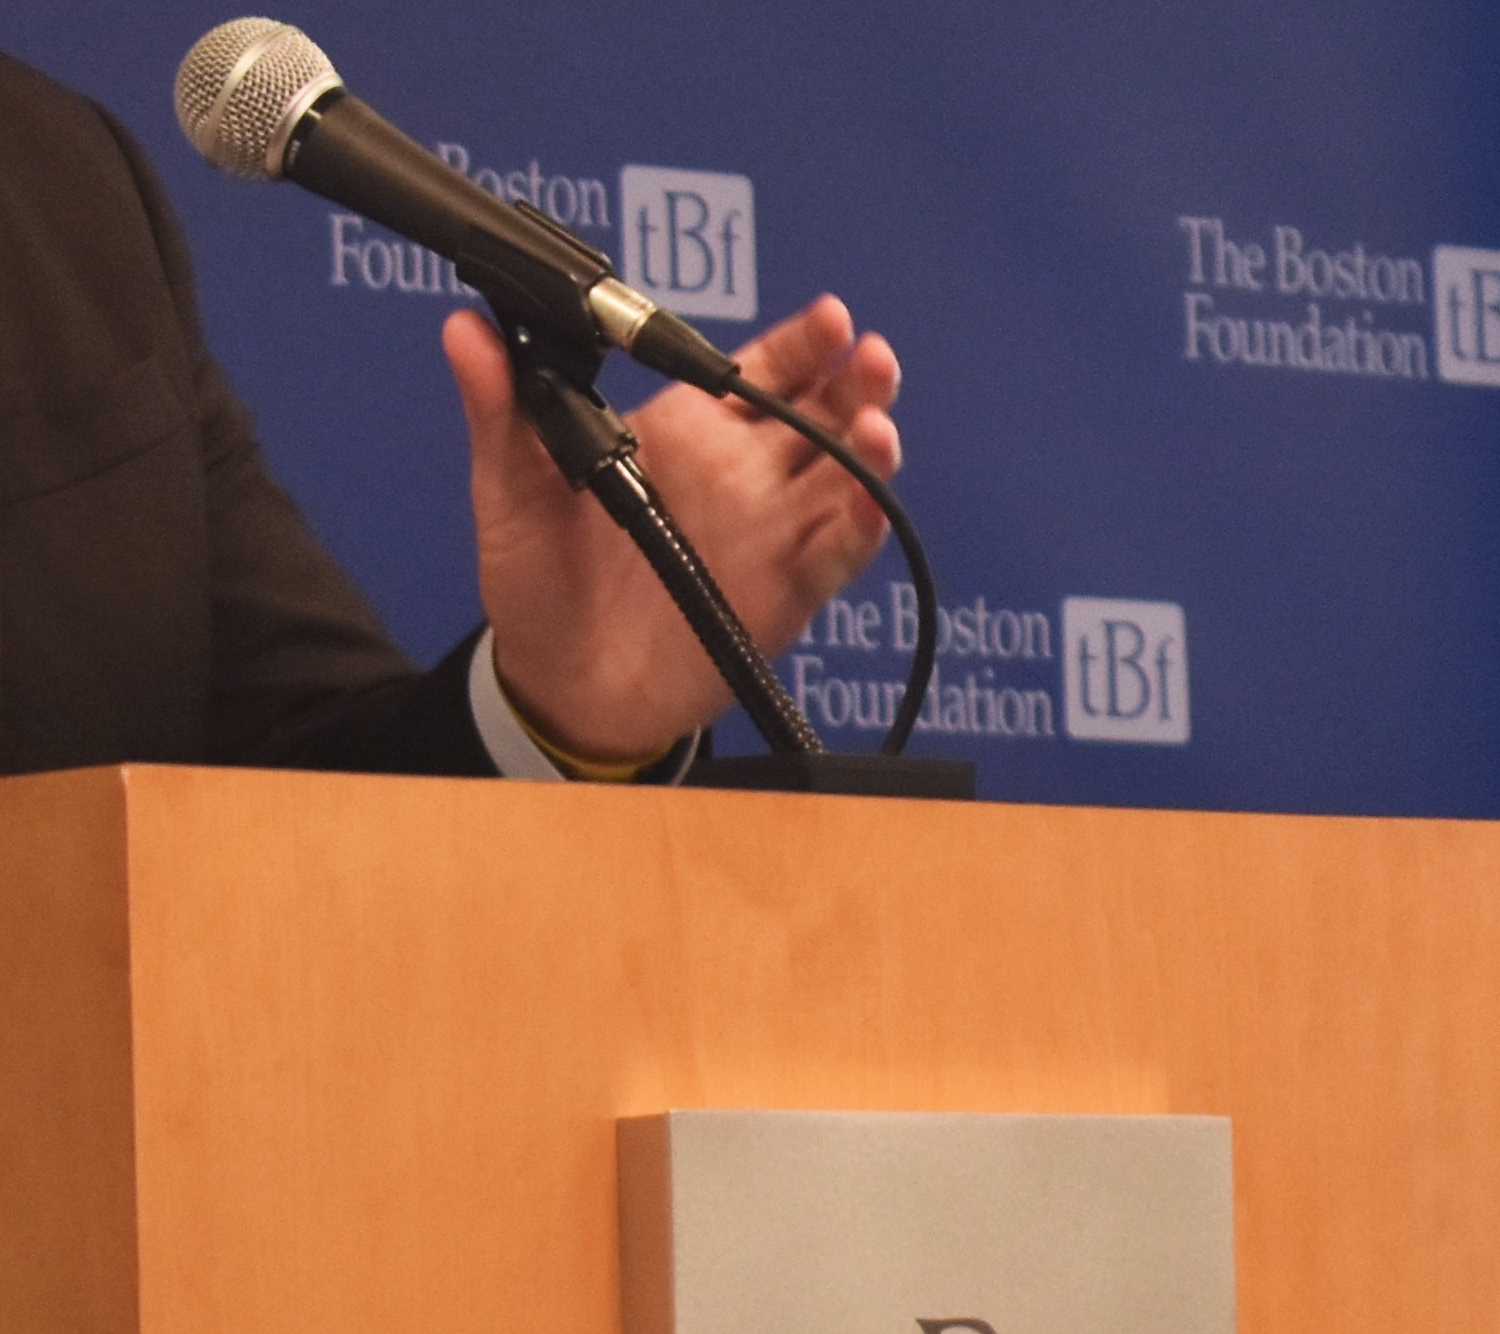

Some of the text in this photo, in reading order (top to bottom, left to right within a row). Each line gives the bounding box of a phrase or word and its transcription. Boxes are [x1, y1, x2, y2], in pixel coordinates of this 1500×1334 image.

[1178, 216, 1426, 305] The Boston
[1184, 292, 1429, 380] Foundation
[800, 597, 882, 650] he
